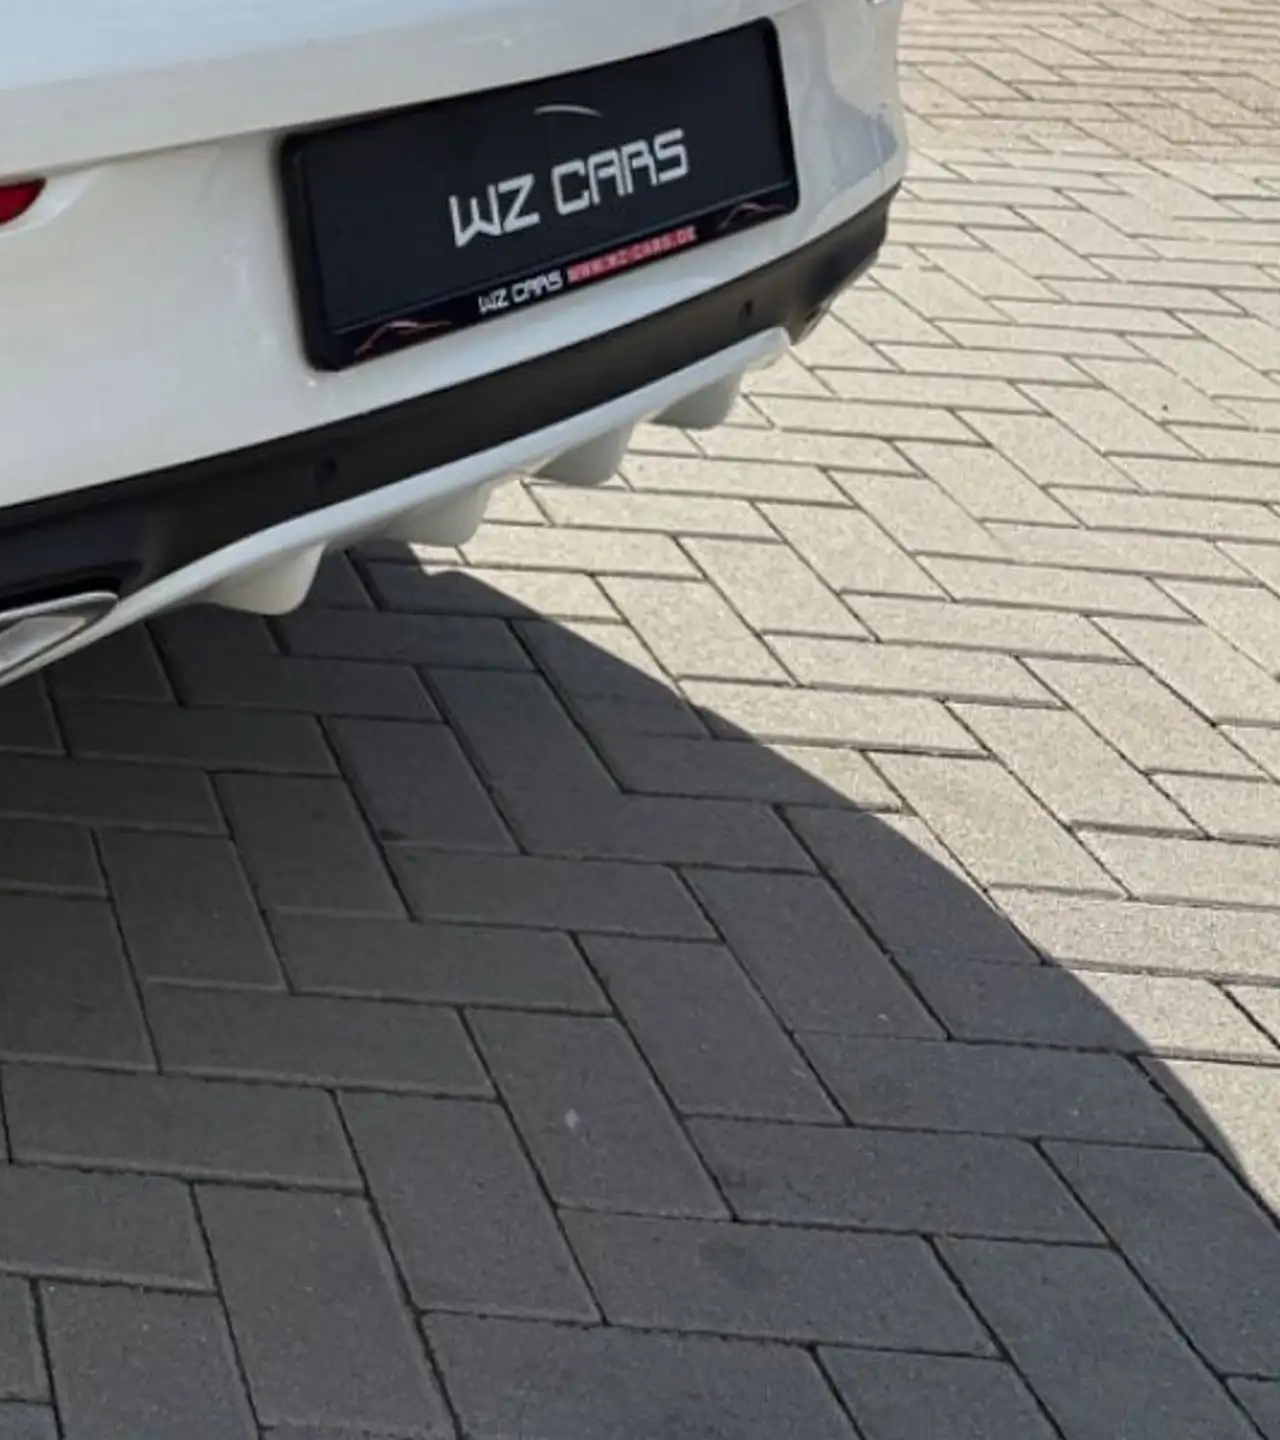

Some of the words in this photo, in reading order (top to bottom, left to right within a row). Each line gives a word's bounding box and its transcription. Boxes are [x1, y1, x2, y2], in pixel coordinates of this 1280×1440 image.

[448, 172, 540, 249] WZ
[550, 127, 689, 217] CARS
[477, 287, 510, 316] WZ
[510, 268, 565, 304] CARS
